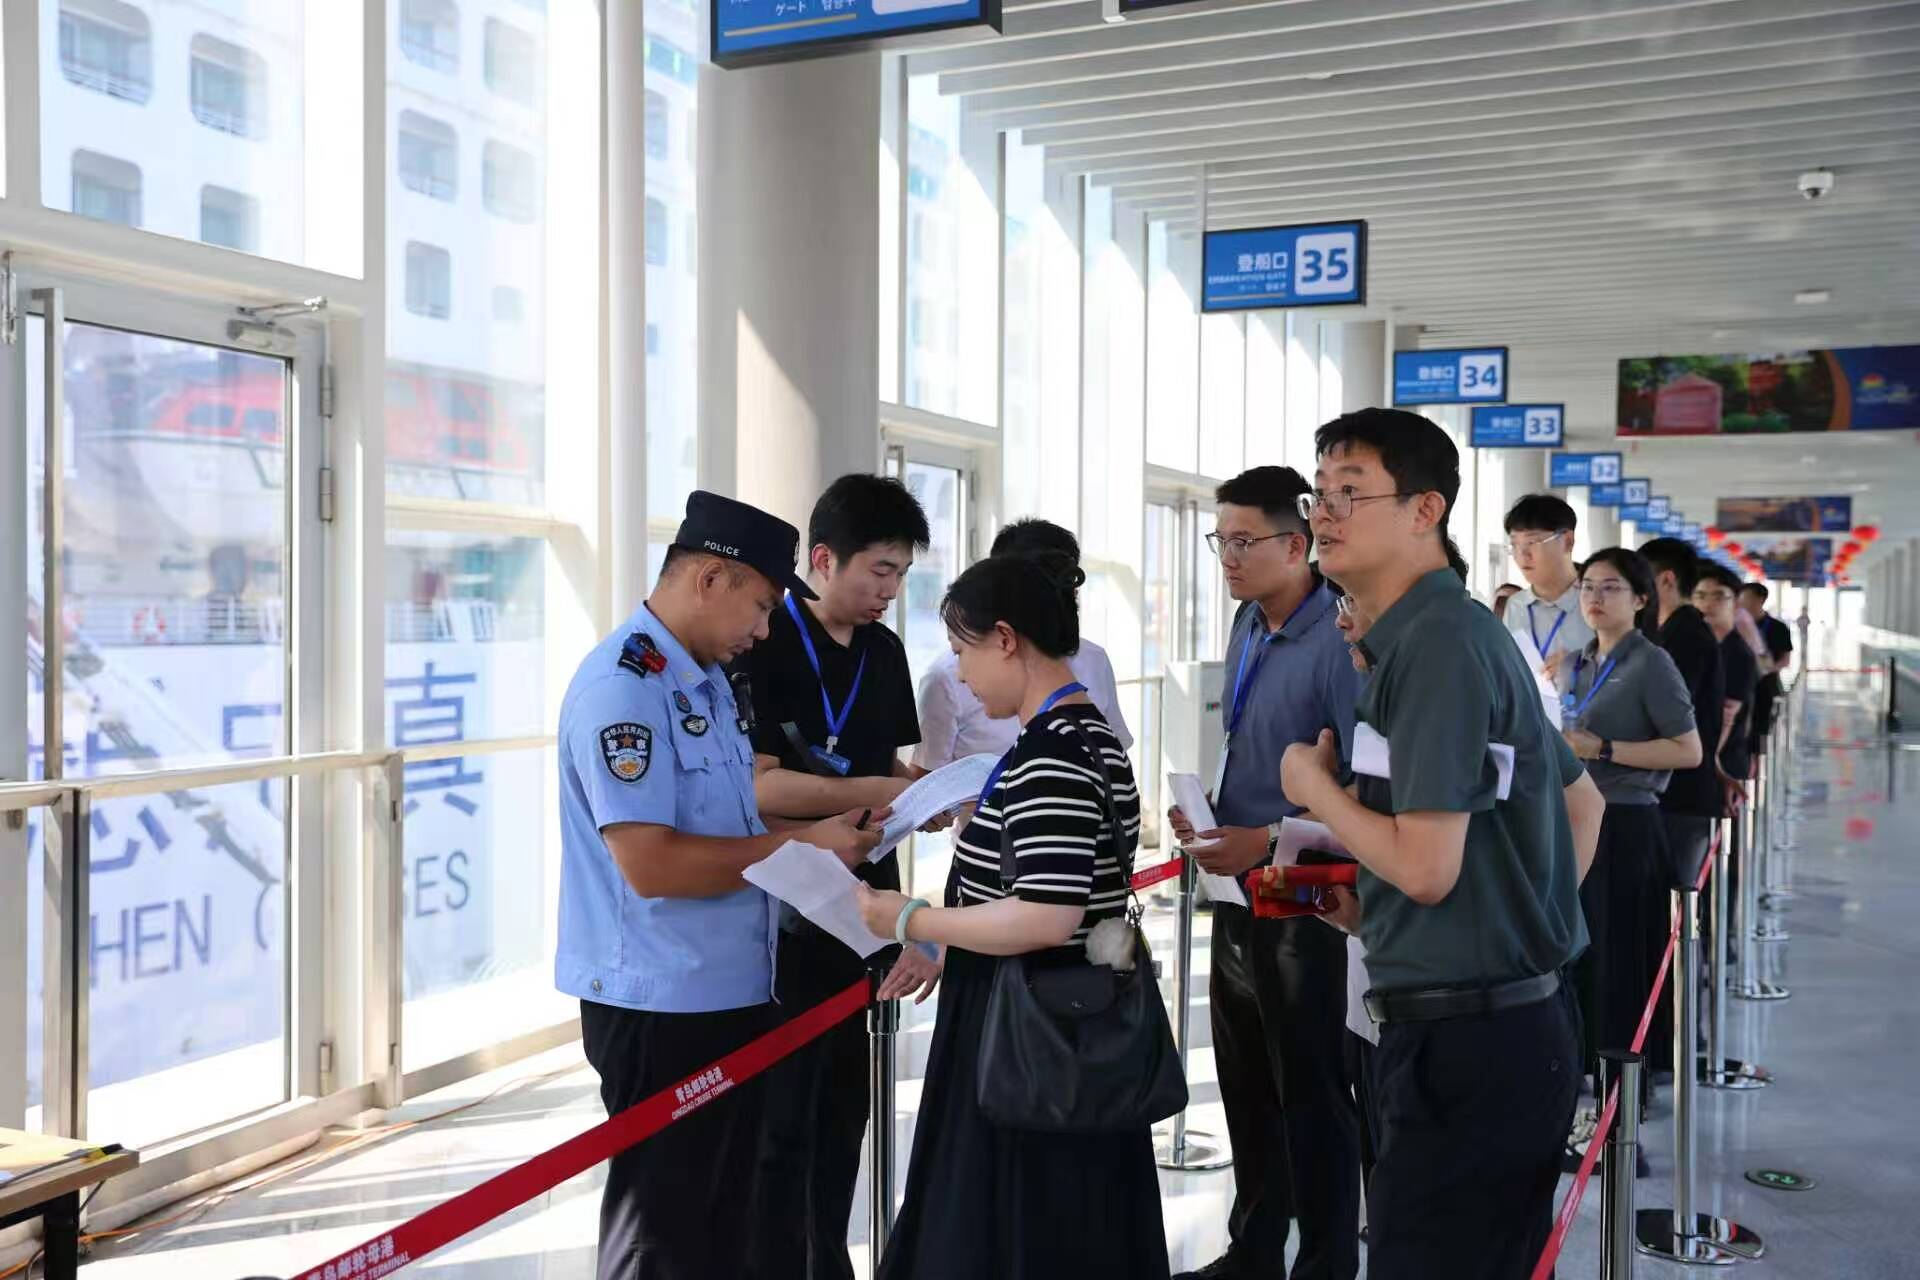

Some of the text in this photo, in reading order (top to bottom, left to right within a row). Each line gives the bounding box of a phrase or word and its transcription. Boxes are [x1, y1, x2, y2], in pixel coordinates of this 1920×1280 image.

[1301, 248, 1348, 283] 35
[1464, 365, 1497, 387] 34
[1528, 417, 1555, 435] 33
[704, 540, 740, 556] POLICE
[402, 849, 471, 919] ES
